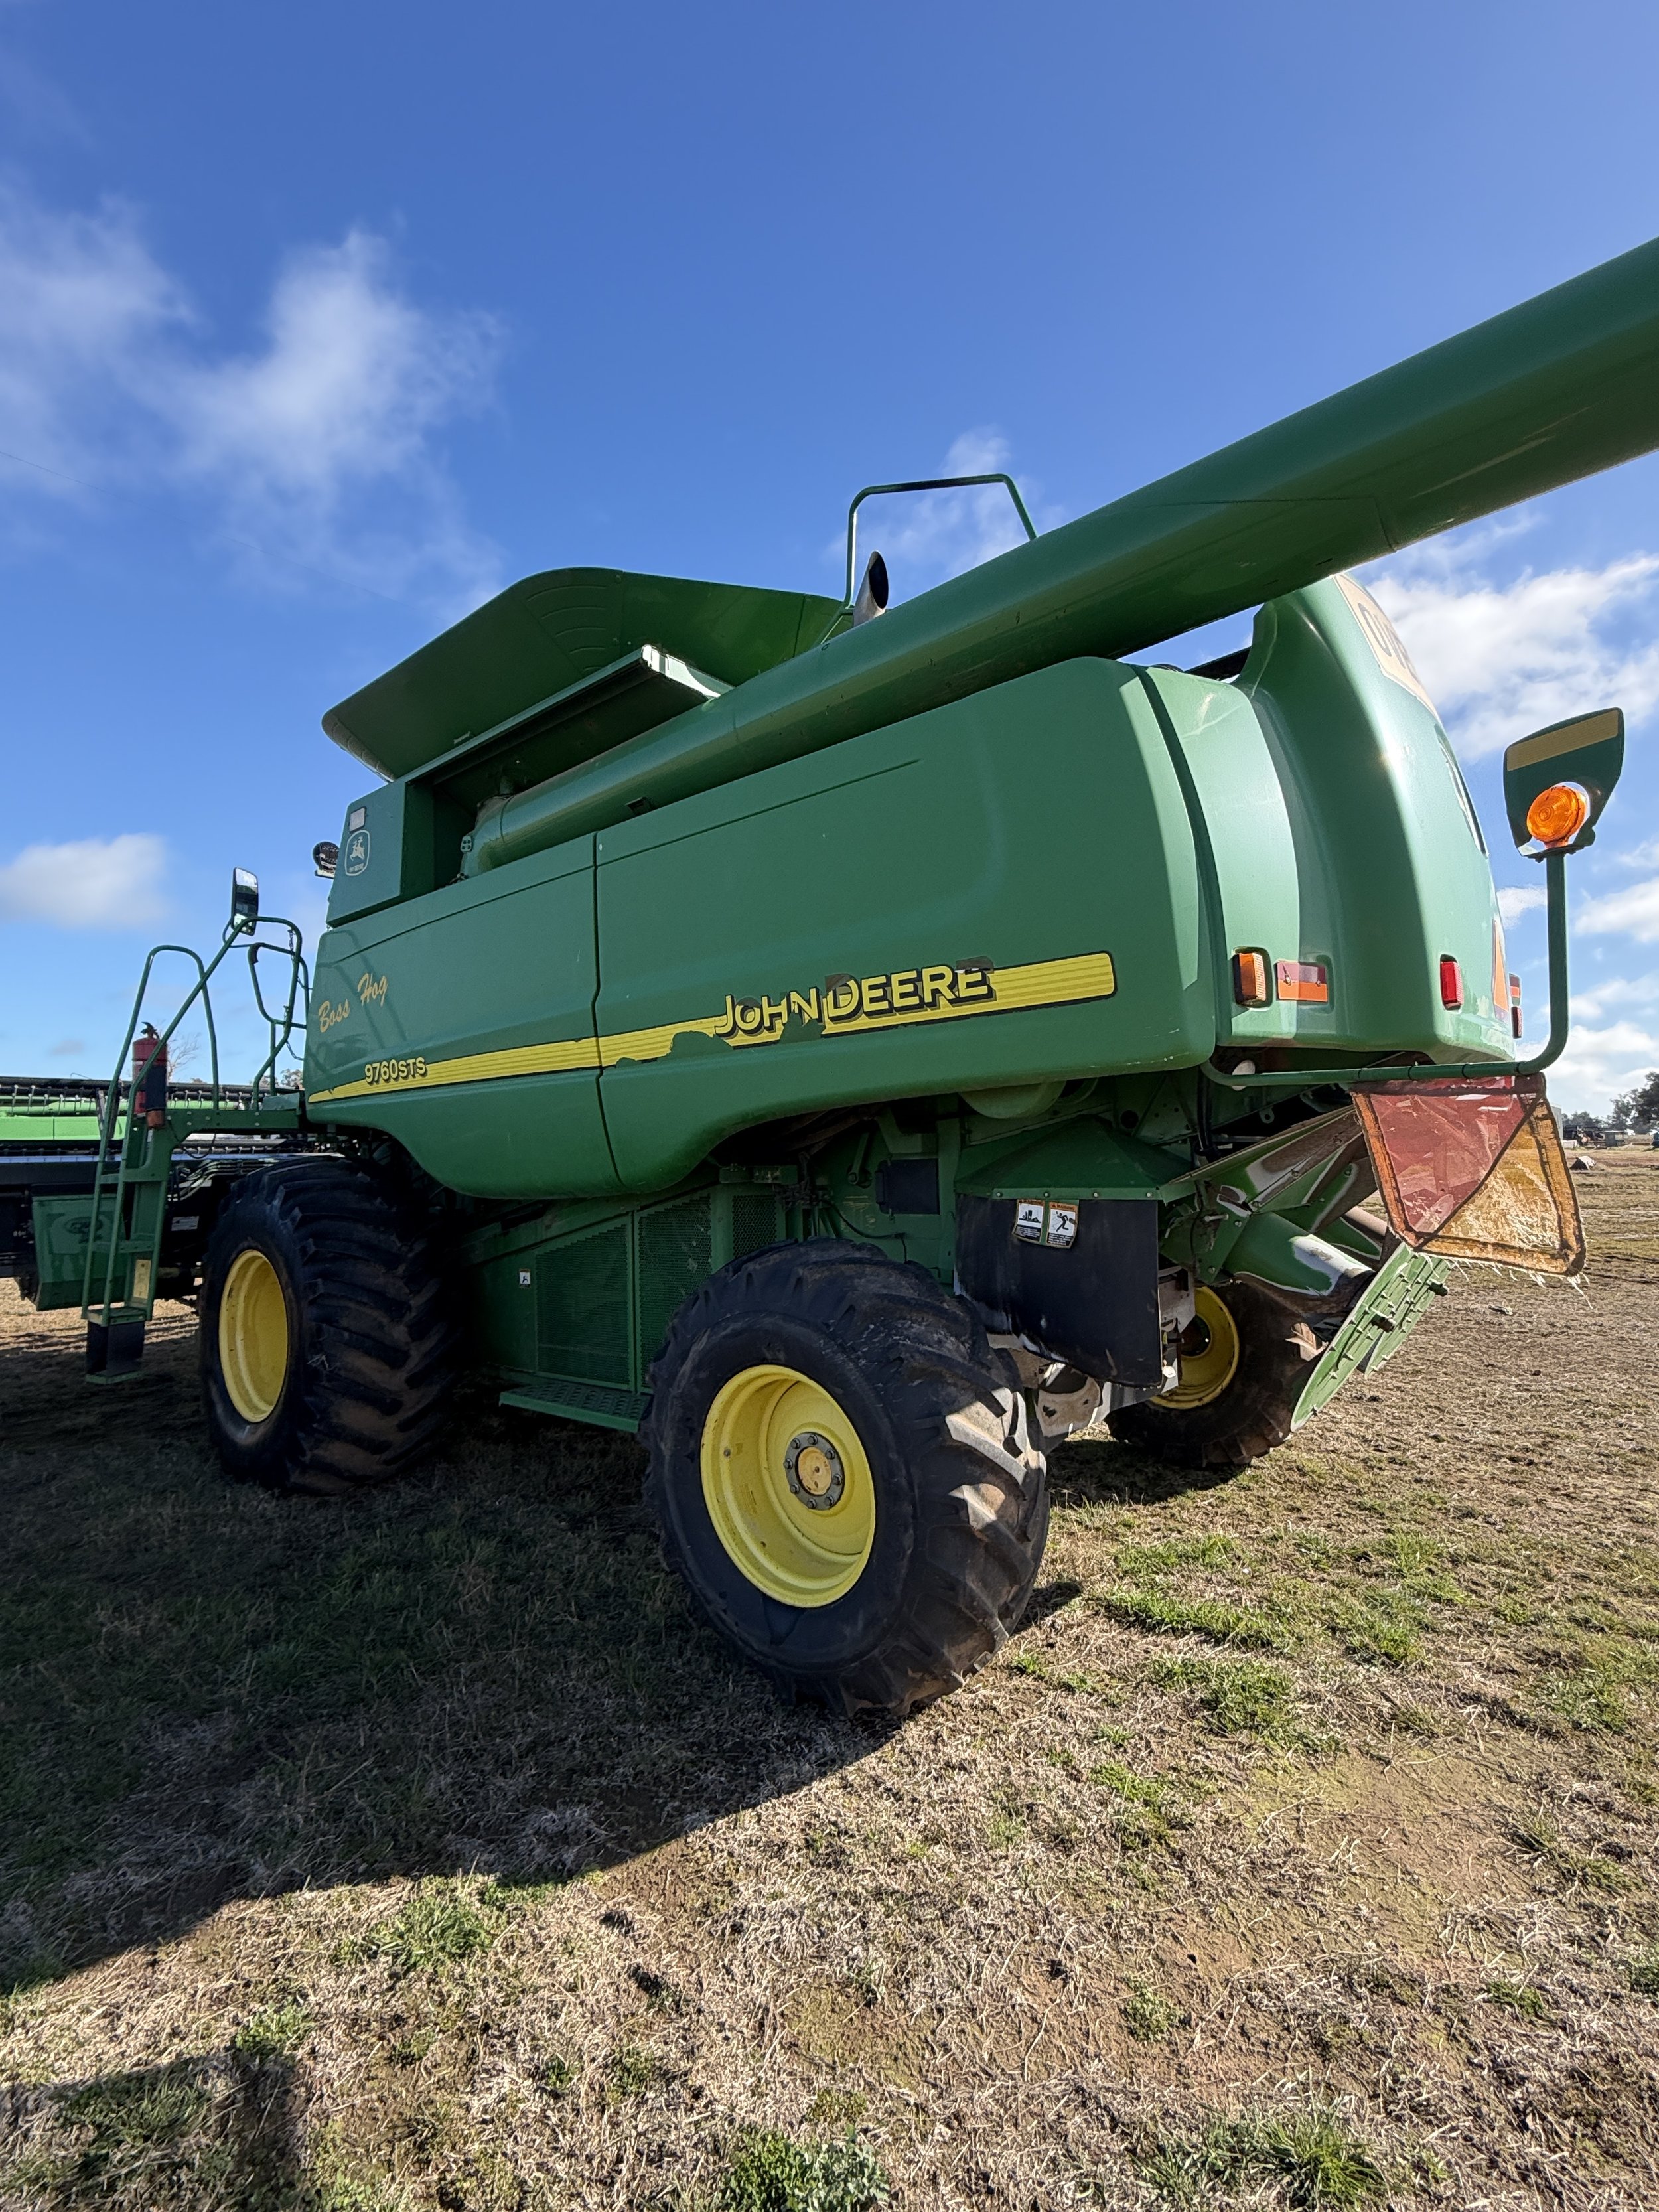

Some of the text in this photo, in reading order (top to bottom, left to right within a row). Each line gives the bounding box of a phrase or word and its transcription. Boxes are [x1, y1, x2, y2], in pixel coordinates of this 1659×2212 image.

[318, 972, 388, 1033] Boss Hog
[714, 960, 991, 1037] JOHN DEERE
[364, 1056, 428, 1084] 9760STS
